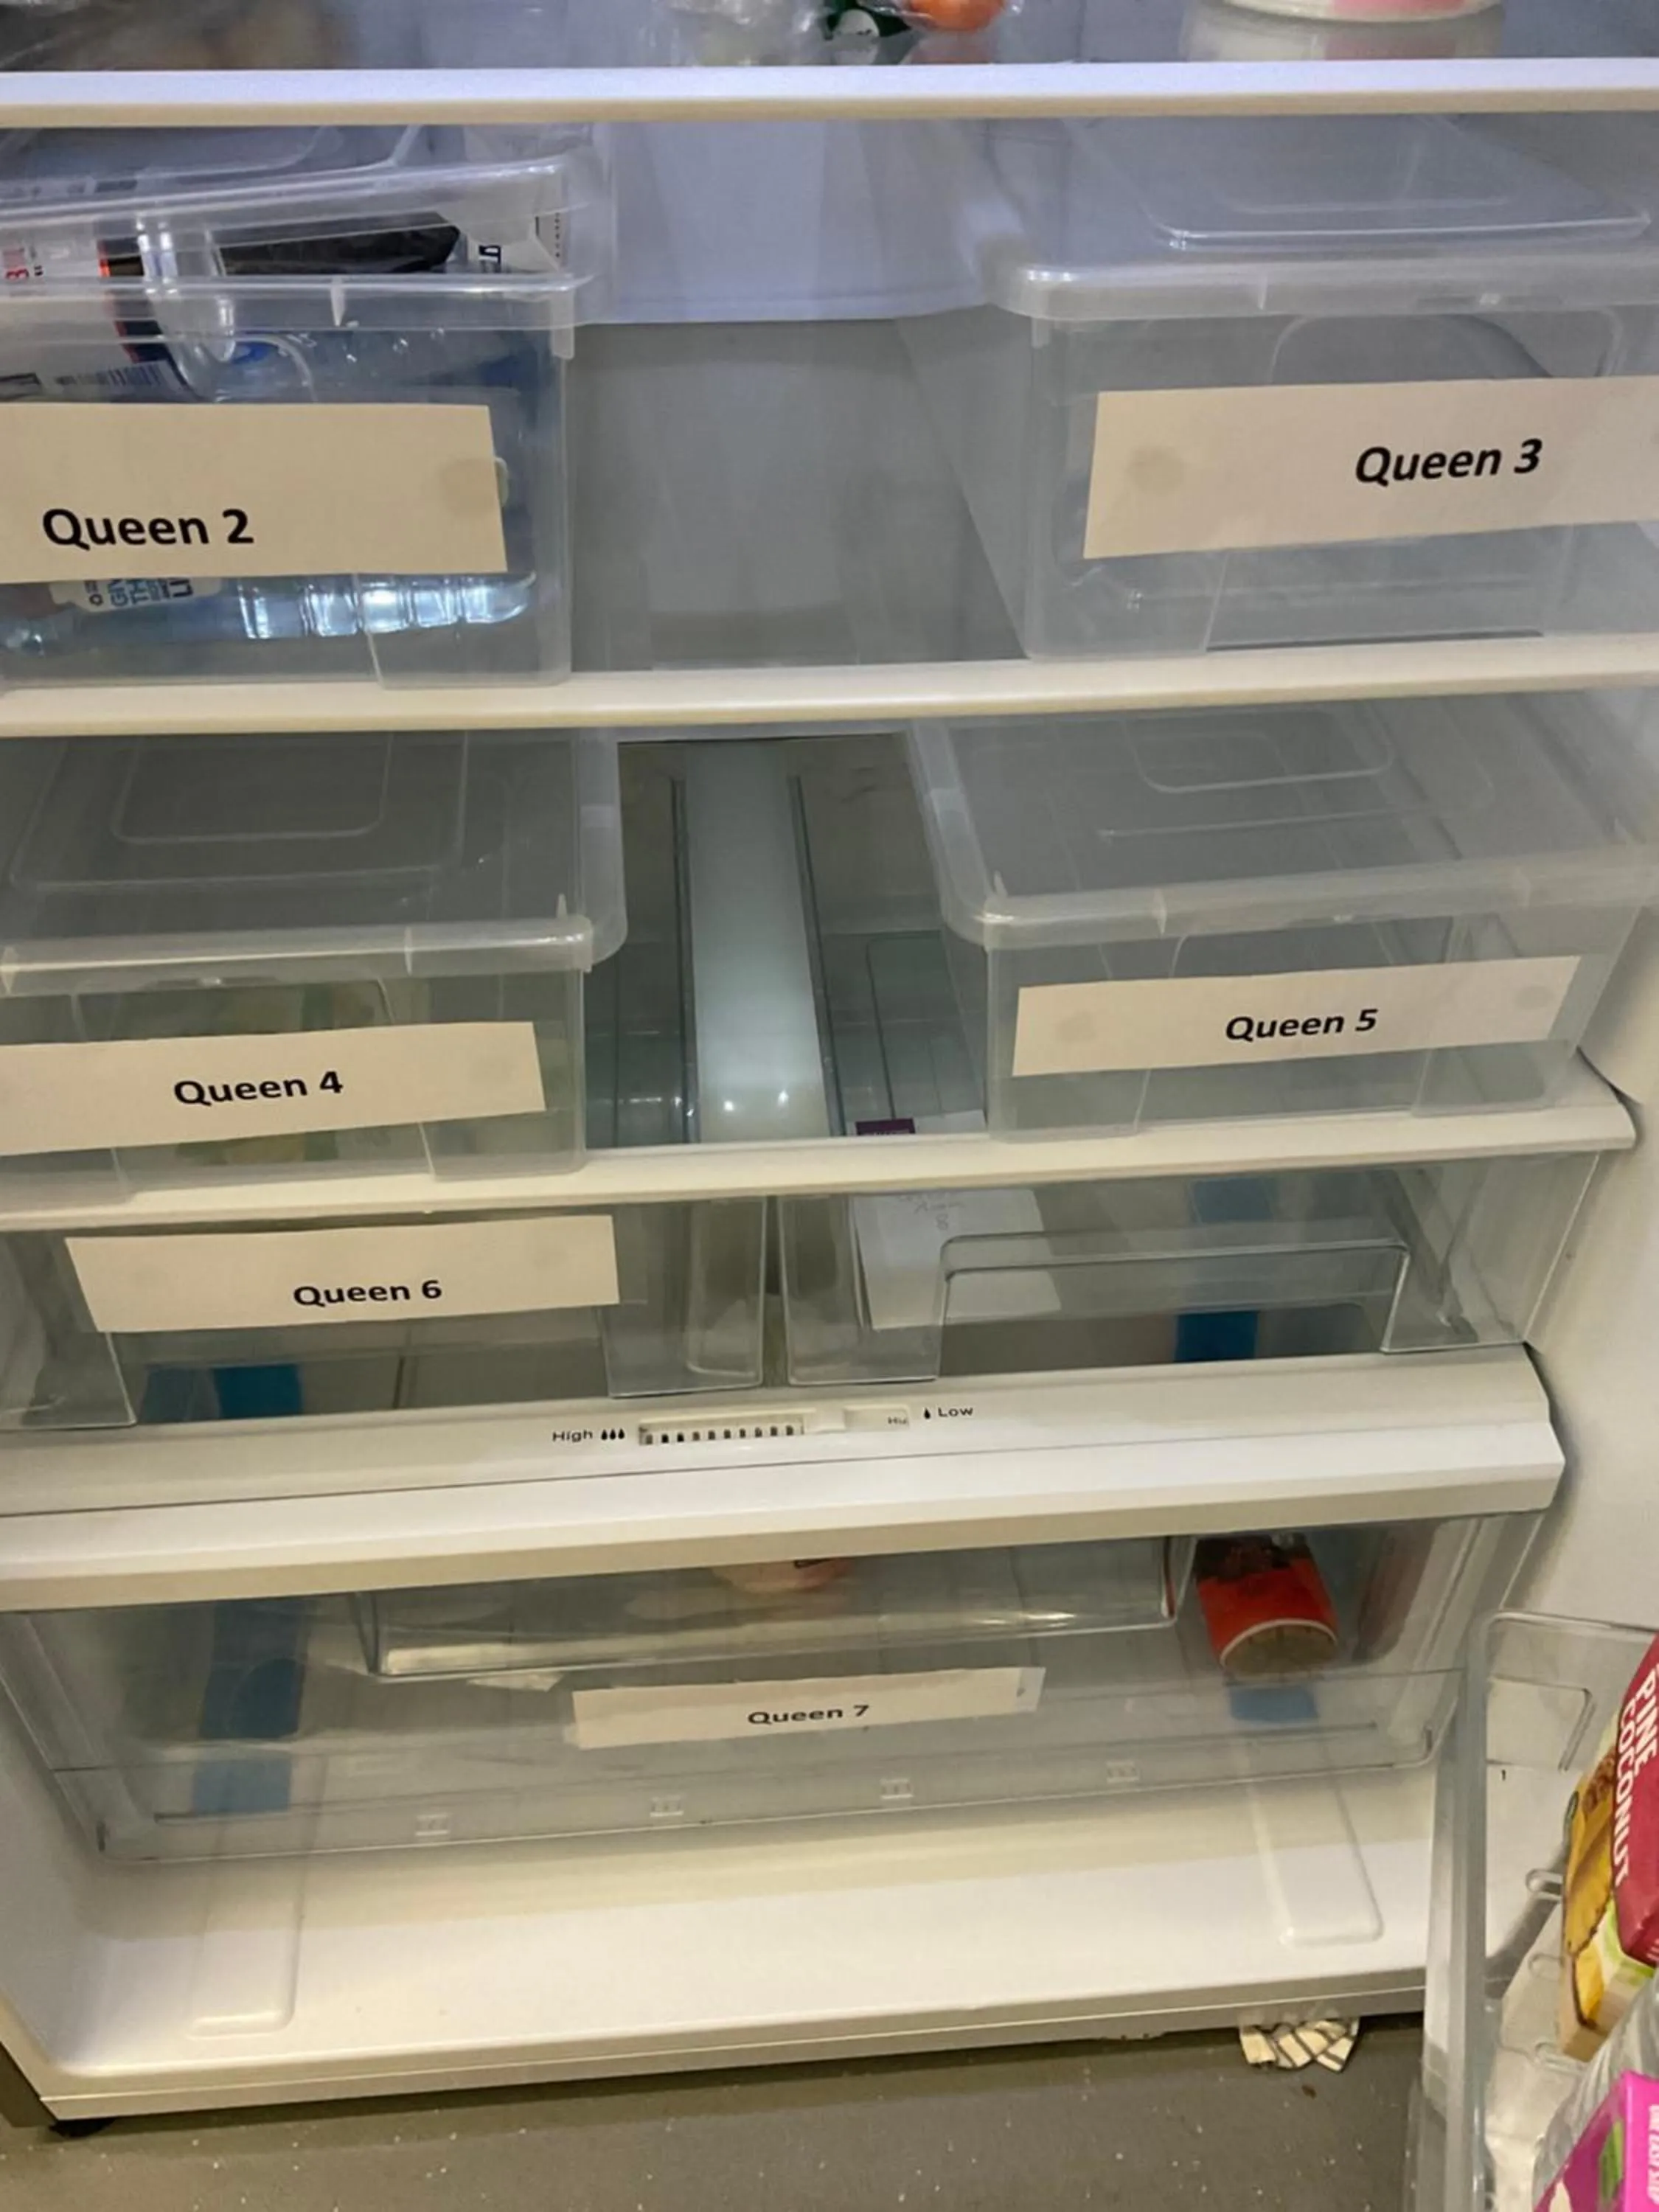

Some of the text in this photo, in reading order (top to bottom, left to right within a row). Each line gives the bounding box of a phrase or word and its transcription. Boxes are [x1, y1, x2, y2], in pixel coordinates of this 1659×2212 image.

[1355, 438, 1543, 487] Queen 3
[42, 508, 254, 551] Queen 2
[1225, 1008, 1378, 1043] Queen 5
[173, 1071, 344, 1107] Queen 4
[293, 1279, 442, 1308] Queen 6
[937, 1407, 973, 1418] Low
[552, 1430, 593, 1443] High
[747, 1704, 871, 1726] Queen 7
[1634, 1669, 1658, 1777] PINE
[1613, 1698, 1635, 1888] COCONUT
